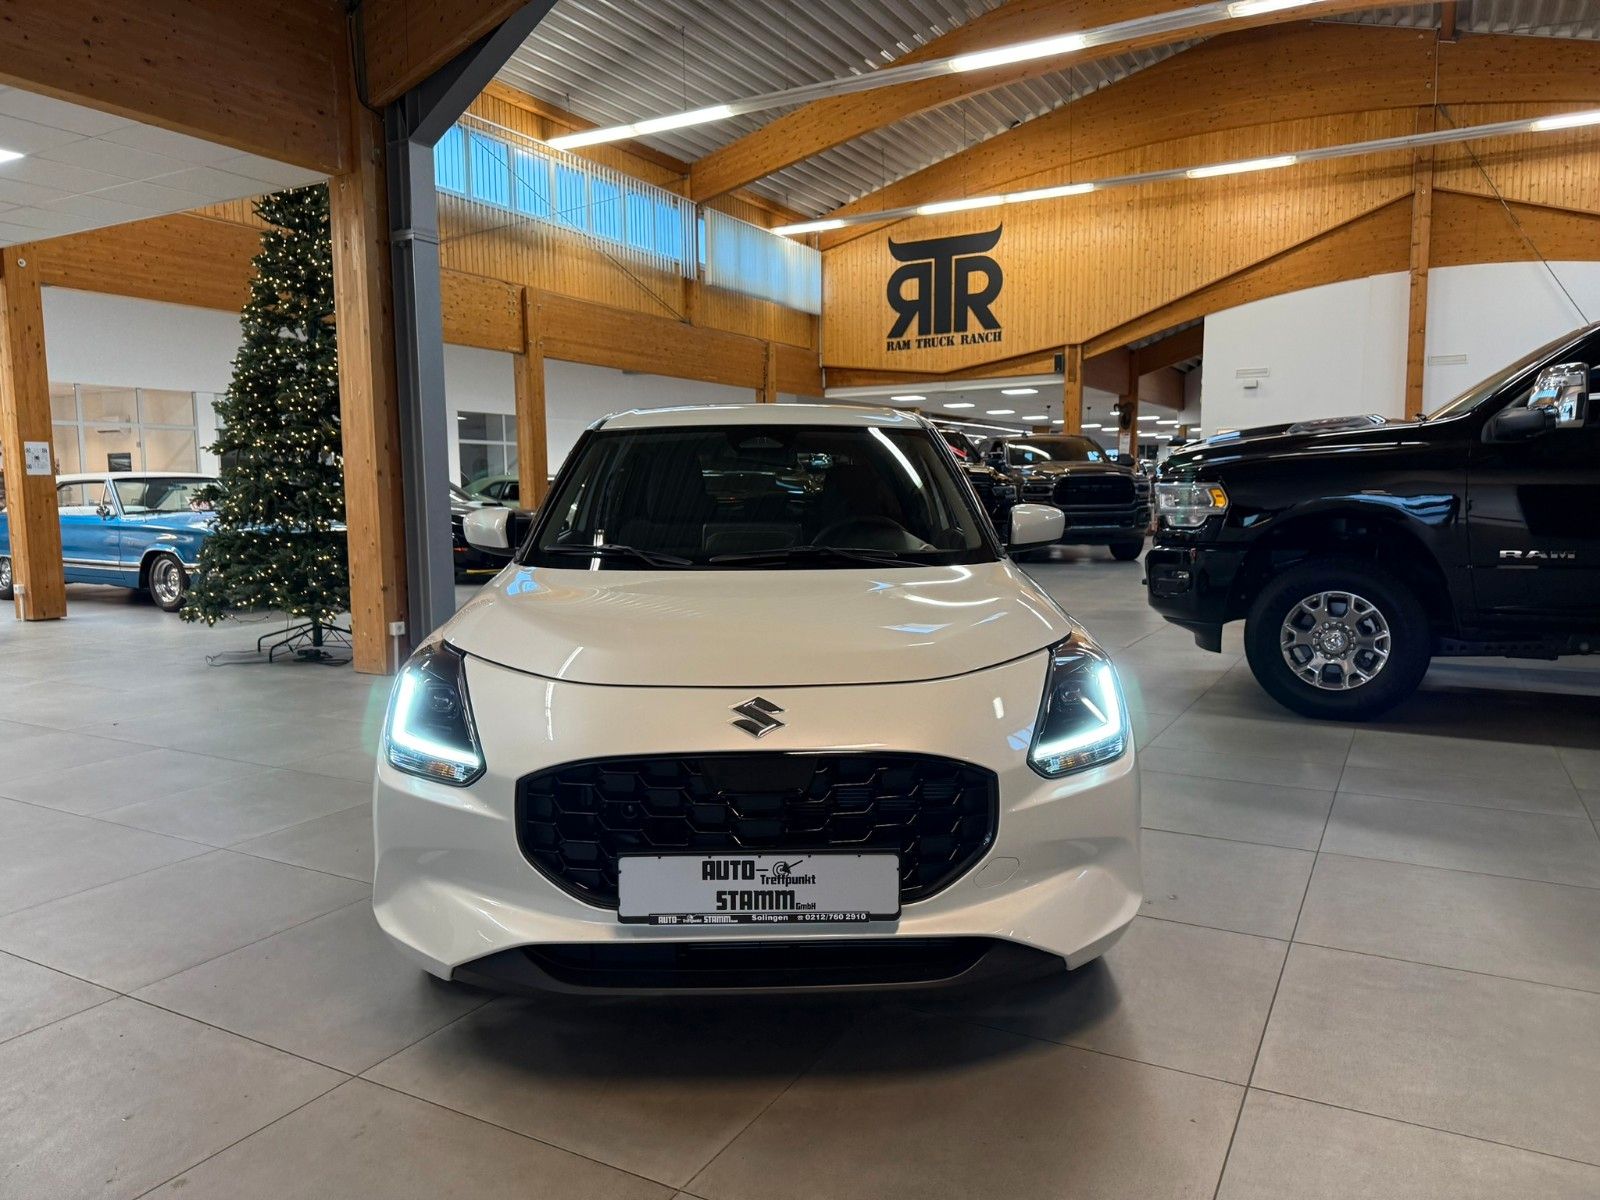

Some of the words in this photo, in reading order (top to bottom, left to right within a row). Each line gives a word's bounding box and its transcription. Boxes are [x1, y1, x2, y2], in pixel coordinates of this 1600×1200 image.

[887, 339, 911, 351] RAM
[915, 335, 955, 349] TRUCK
[960, 330, 1003, 345] RANCH
[760, 874, 816, 887] Treffpunkt
[716, 890, 795, 910] STAMM
[795, 902, 816, 911] GmbH
[703, 915, 731, 924] STAMM
[751, 914, 789, 922] Solingen
[805, 913, 844, 921] 0212/760
[845, 912, 867, 920] 2910
